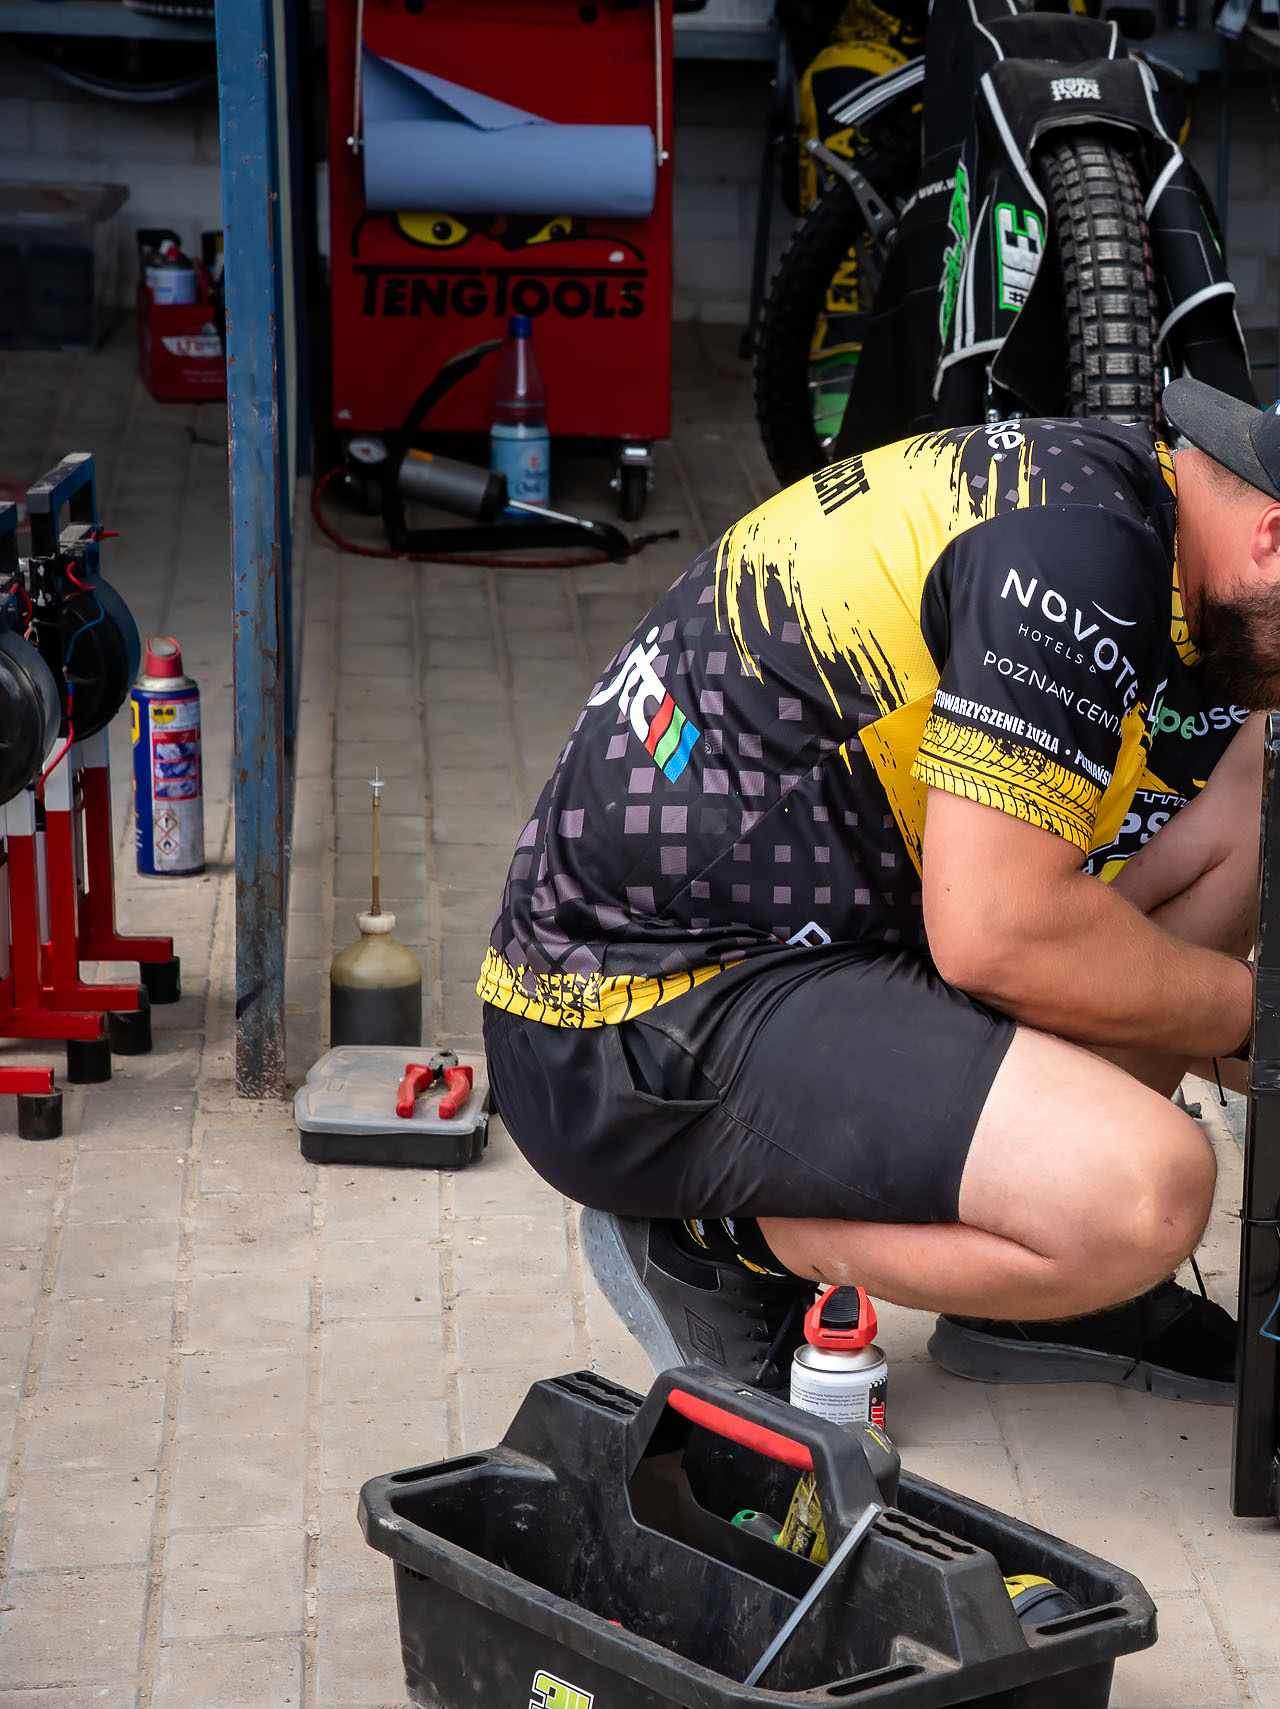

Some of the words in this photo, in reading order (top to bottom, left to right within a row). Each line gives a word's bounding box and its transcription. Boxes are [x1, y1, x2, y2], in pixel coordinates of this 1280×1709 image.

[1018, 623, 1084, 664] HOTELS
[933, 689, 1026, 736] STOWARZYSZENIE
[1077, 698, 1122, 739] CENT
